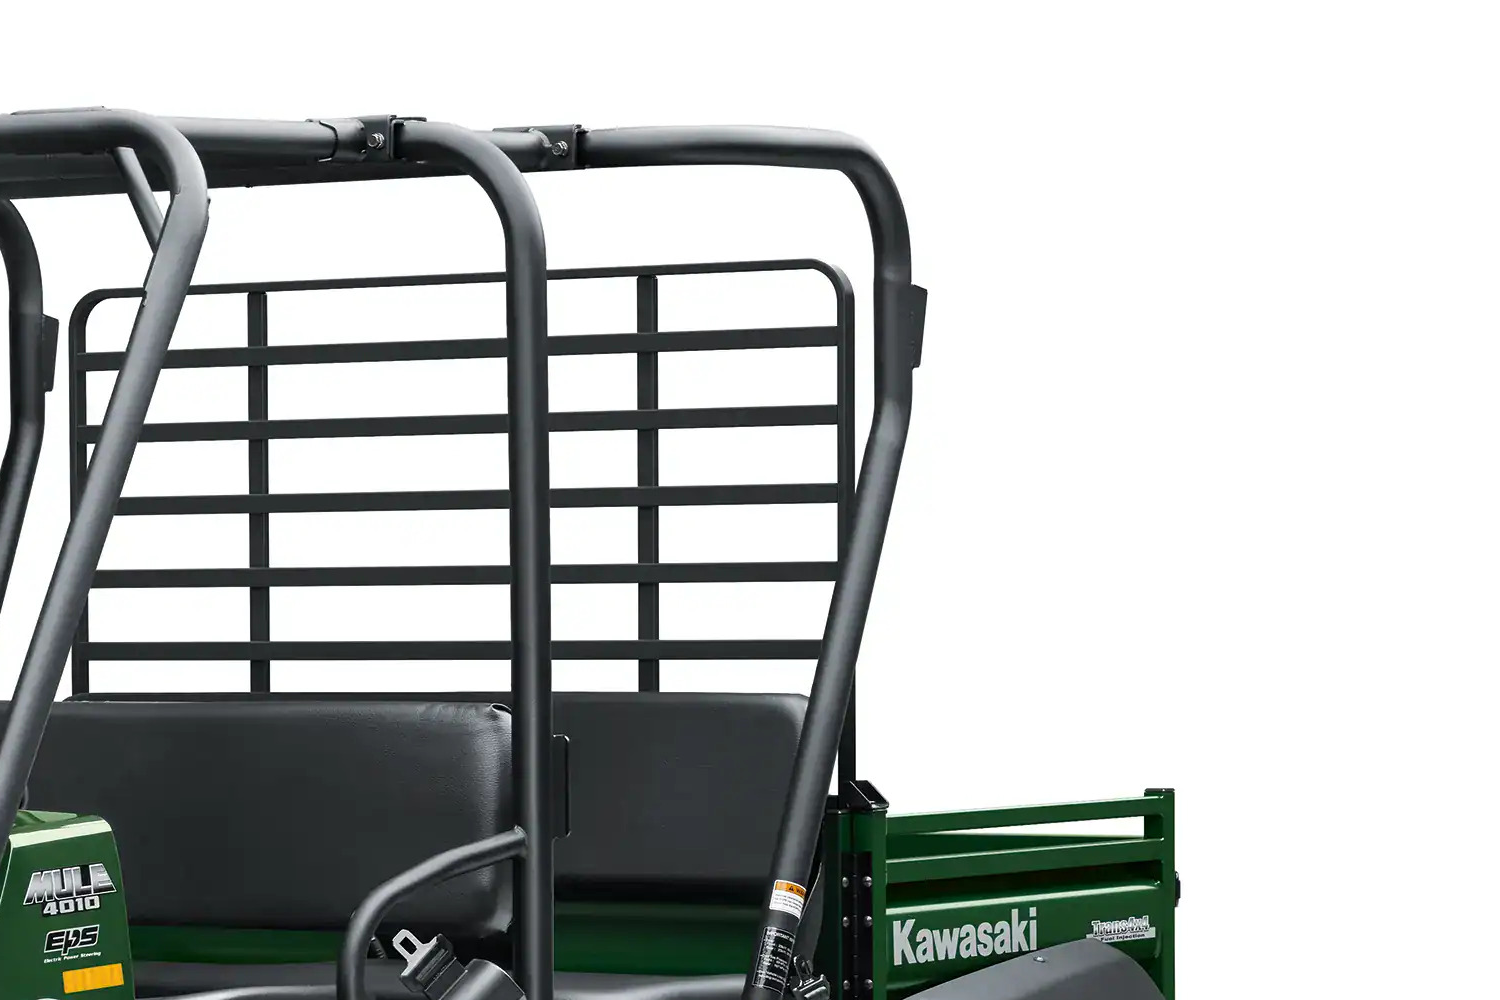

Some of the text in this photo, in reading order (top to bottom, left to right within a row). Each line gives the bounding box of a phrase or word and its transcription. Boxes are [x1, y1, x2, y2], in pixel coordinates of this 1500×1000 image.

[23, 863, 117, 905] MULE
[43, 895, 100, 915] 4010
[893, 906, 1038, 966] Kawasaki
[1091, 915, 1150, 937] Trans4x4
